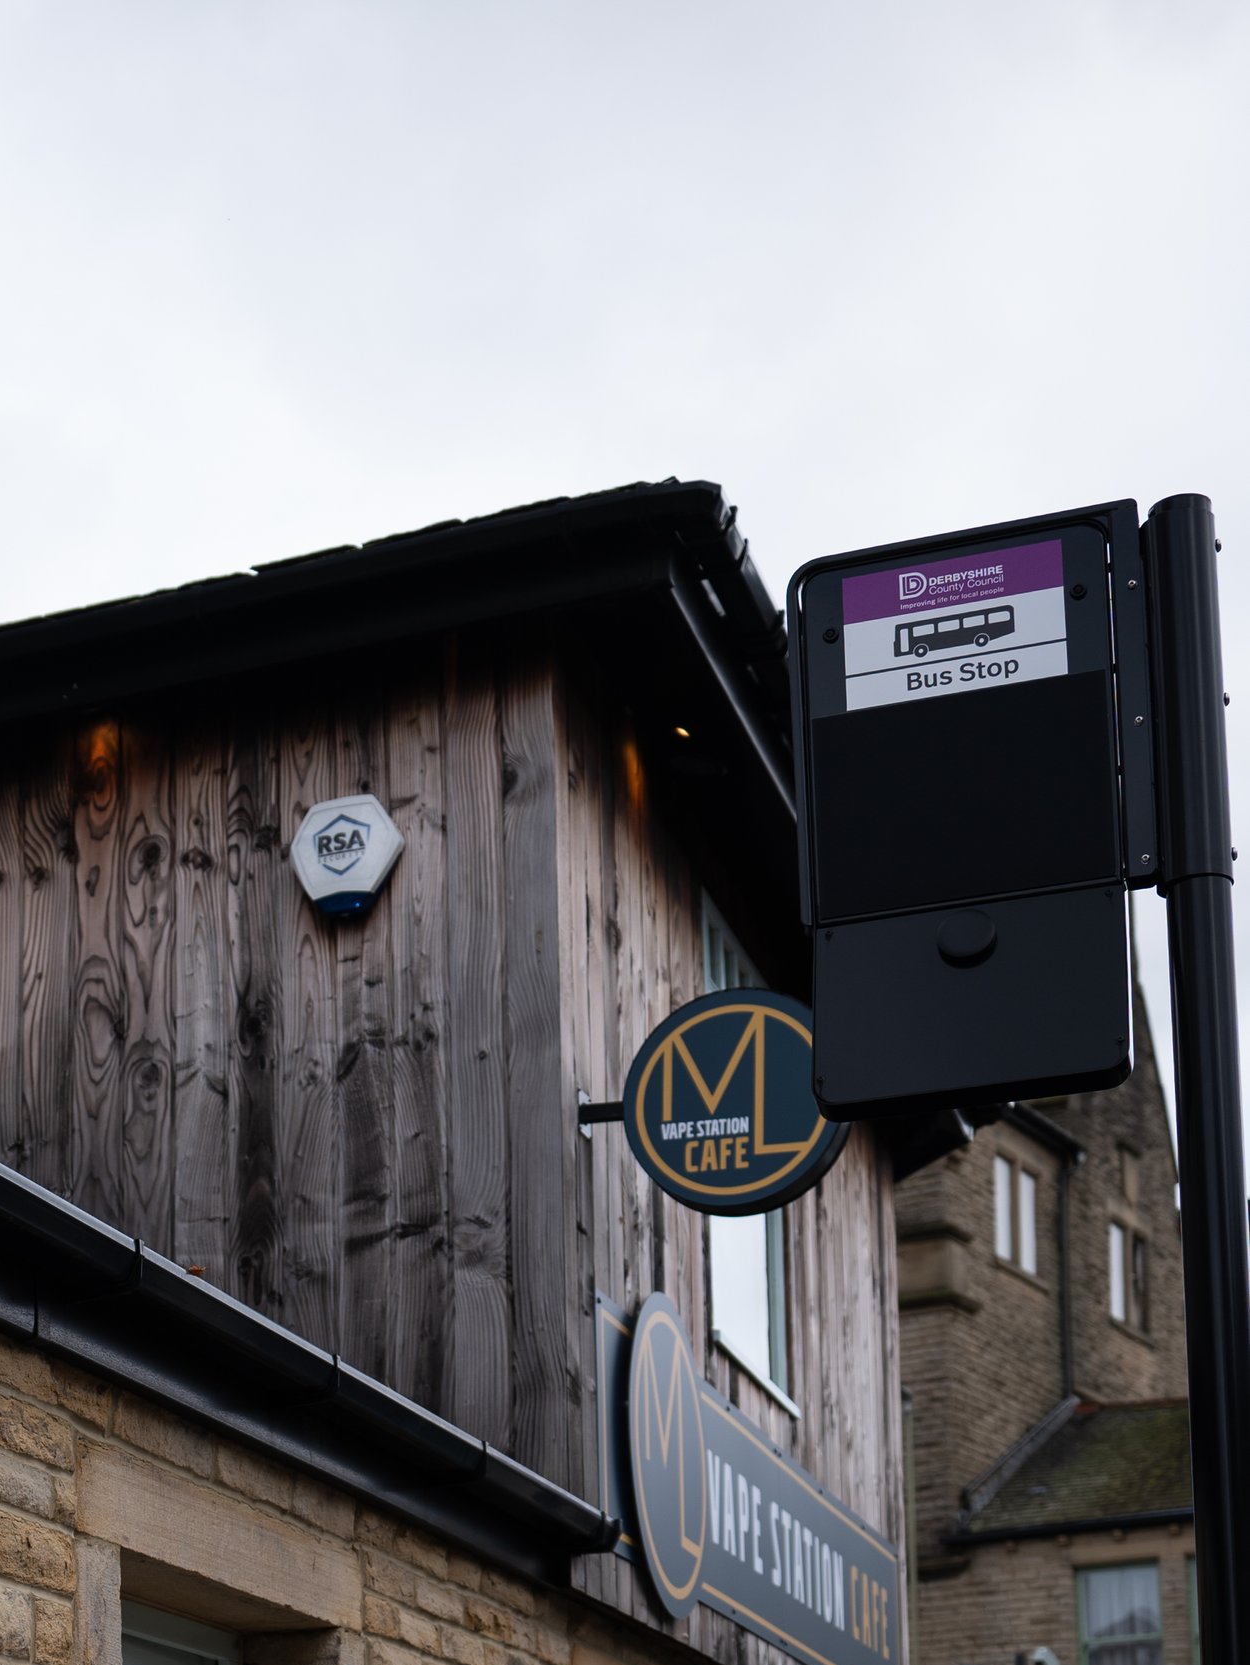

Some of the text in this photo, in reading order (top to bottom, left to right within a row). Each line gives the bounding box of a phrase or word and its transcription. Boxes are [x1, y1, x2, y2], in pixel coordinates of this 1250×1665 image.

[928, 565, 1004, 587] DERBYSHIRE
[929, 574, 1004, 596] County Council
[900, 599, 936, 610] Improving
[937, 596, 948, 604] life
[961, 589, 979, 599] local
[979, 587, 1005, 597] people
[907, 659, 1020, 692] Bus Stop
[318, 829, 365, 855] RSA
[661, 1116, 750, 1140] VAPE STATION
[685, 1136, 750, 1173] CAFE
[707, 1449, 890, 1660] VAPE STATION CAFE
